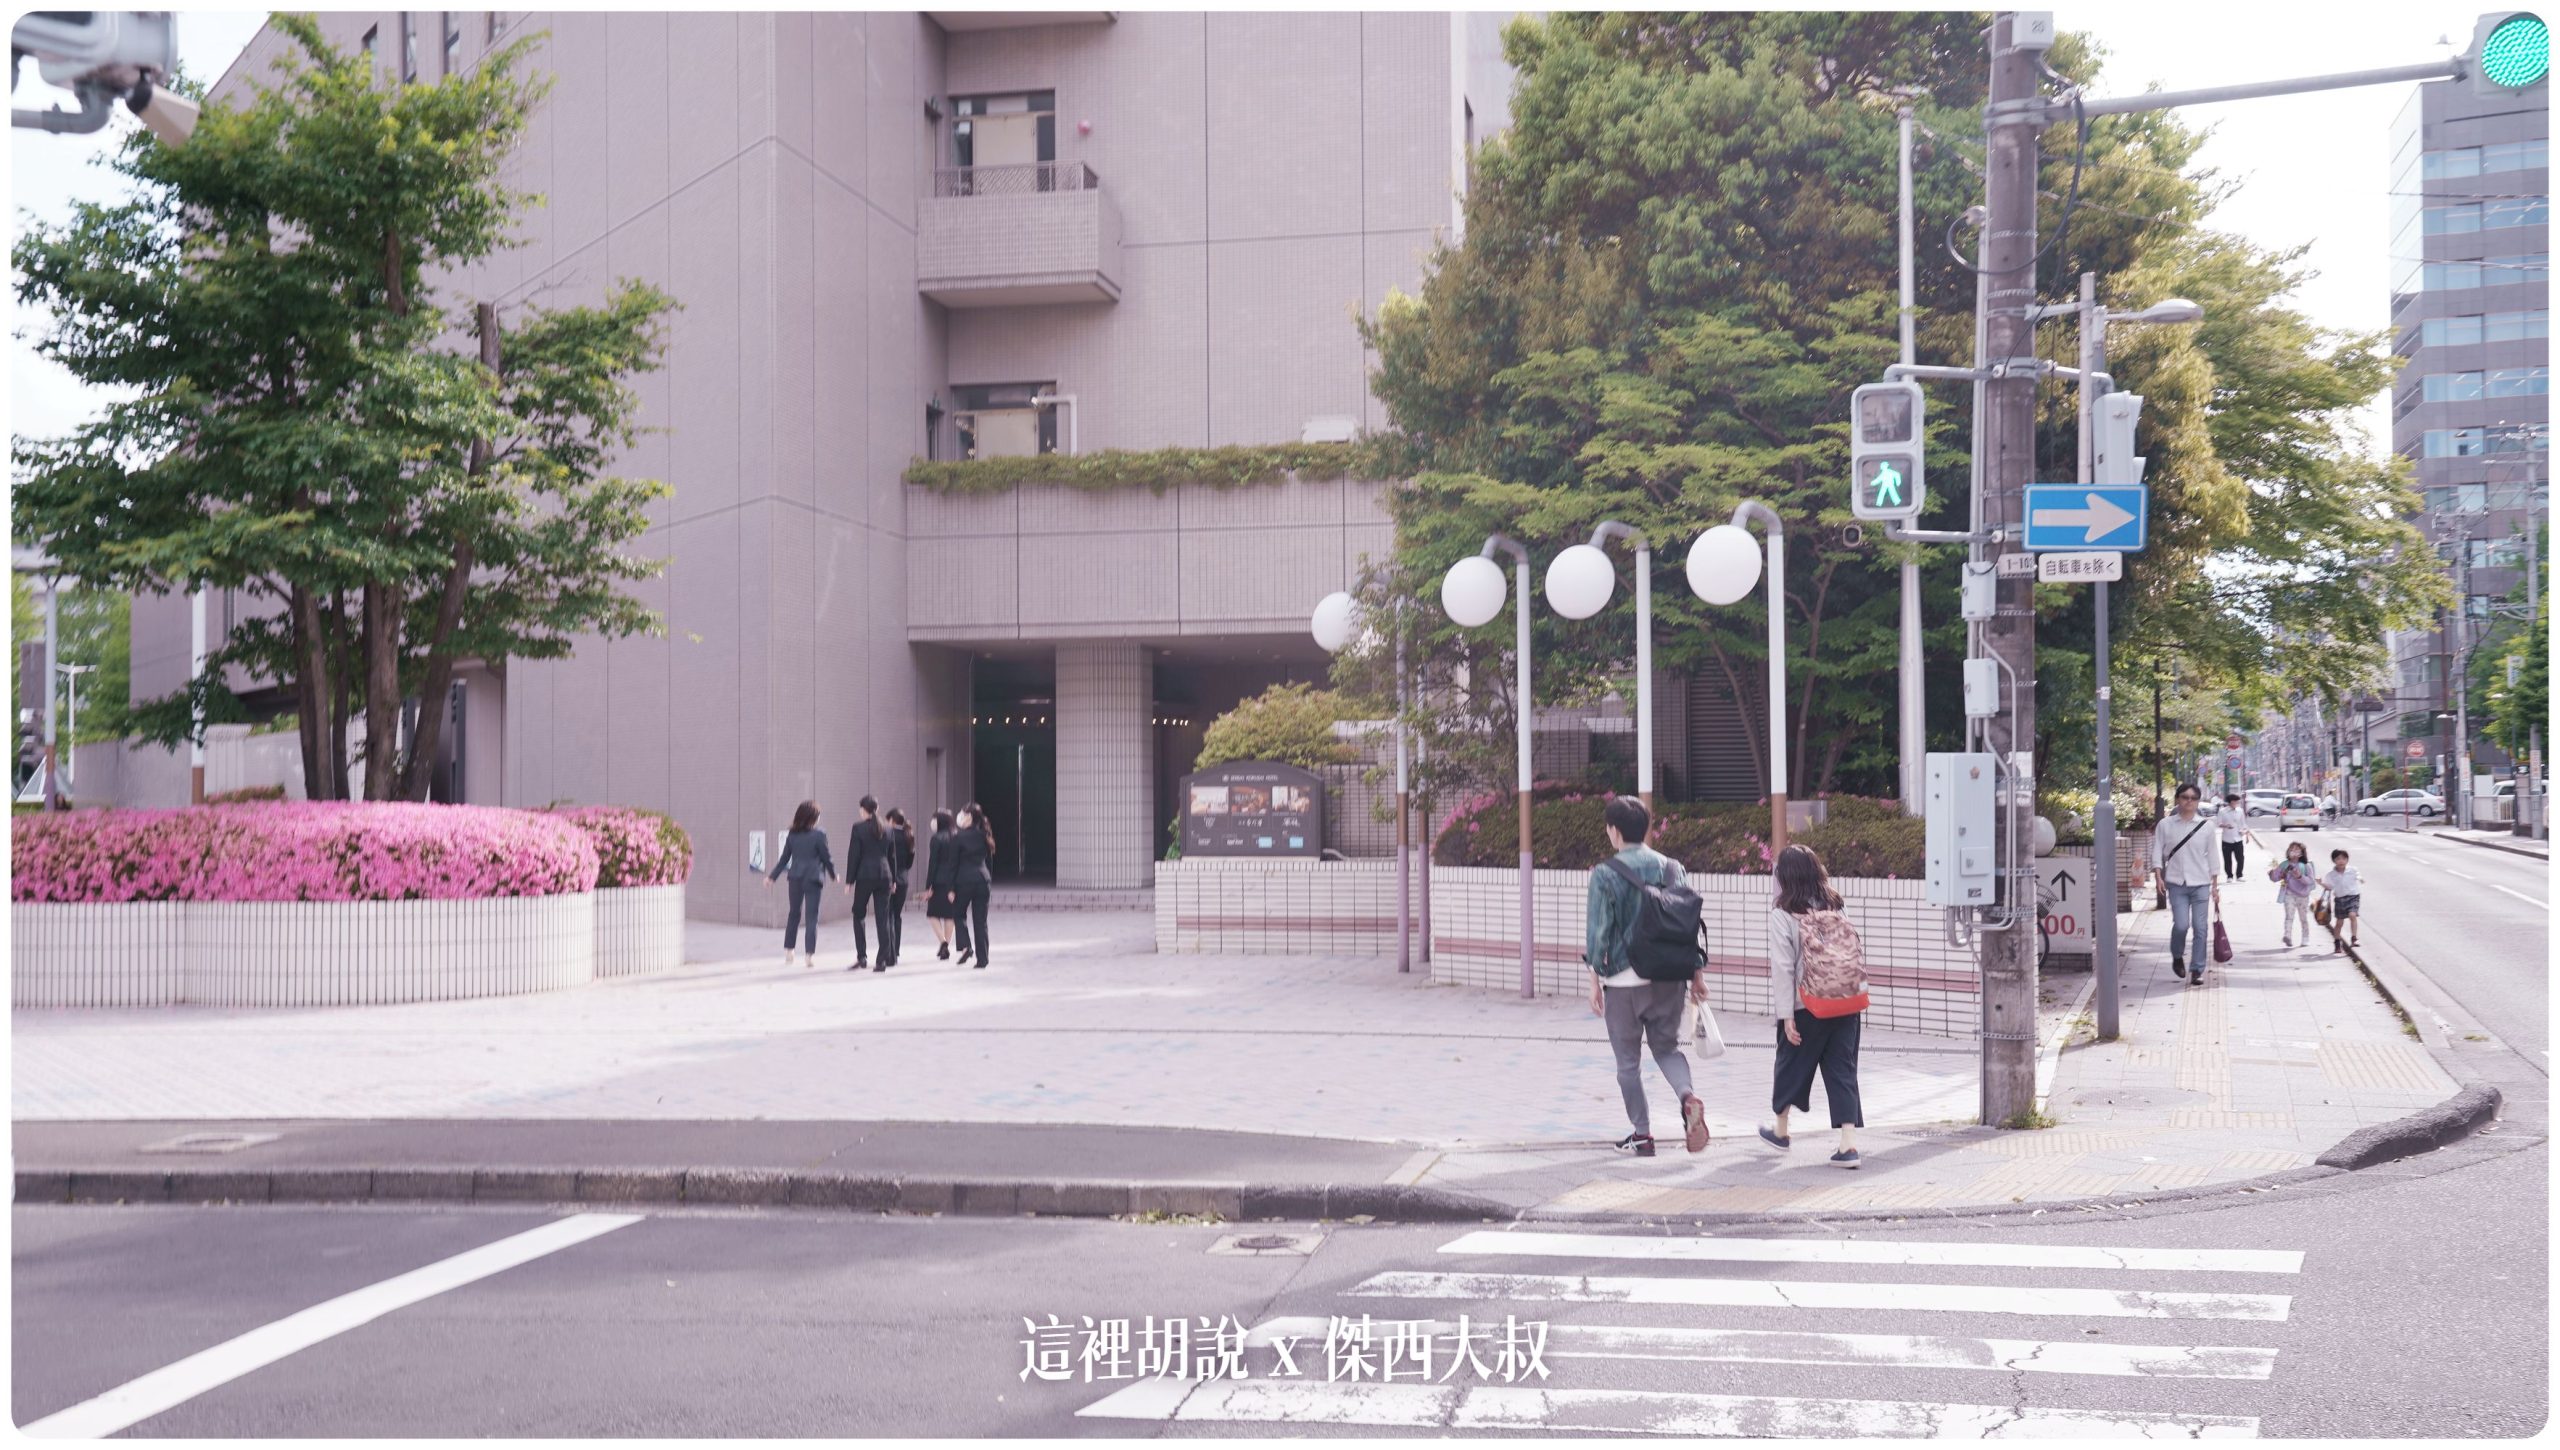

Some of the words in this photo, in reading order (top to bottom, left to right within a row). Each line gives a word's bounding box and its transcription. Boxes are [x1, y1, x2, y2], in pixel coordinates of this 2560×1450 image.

[2045, 558, 2115, 576] 自転車を除く
[2037, 914, 2085, 936] 00円
